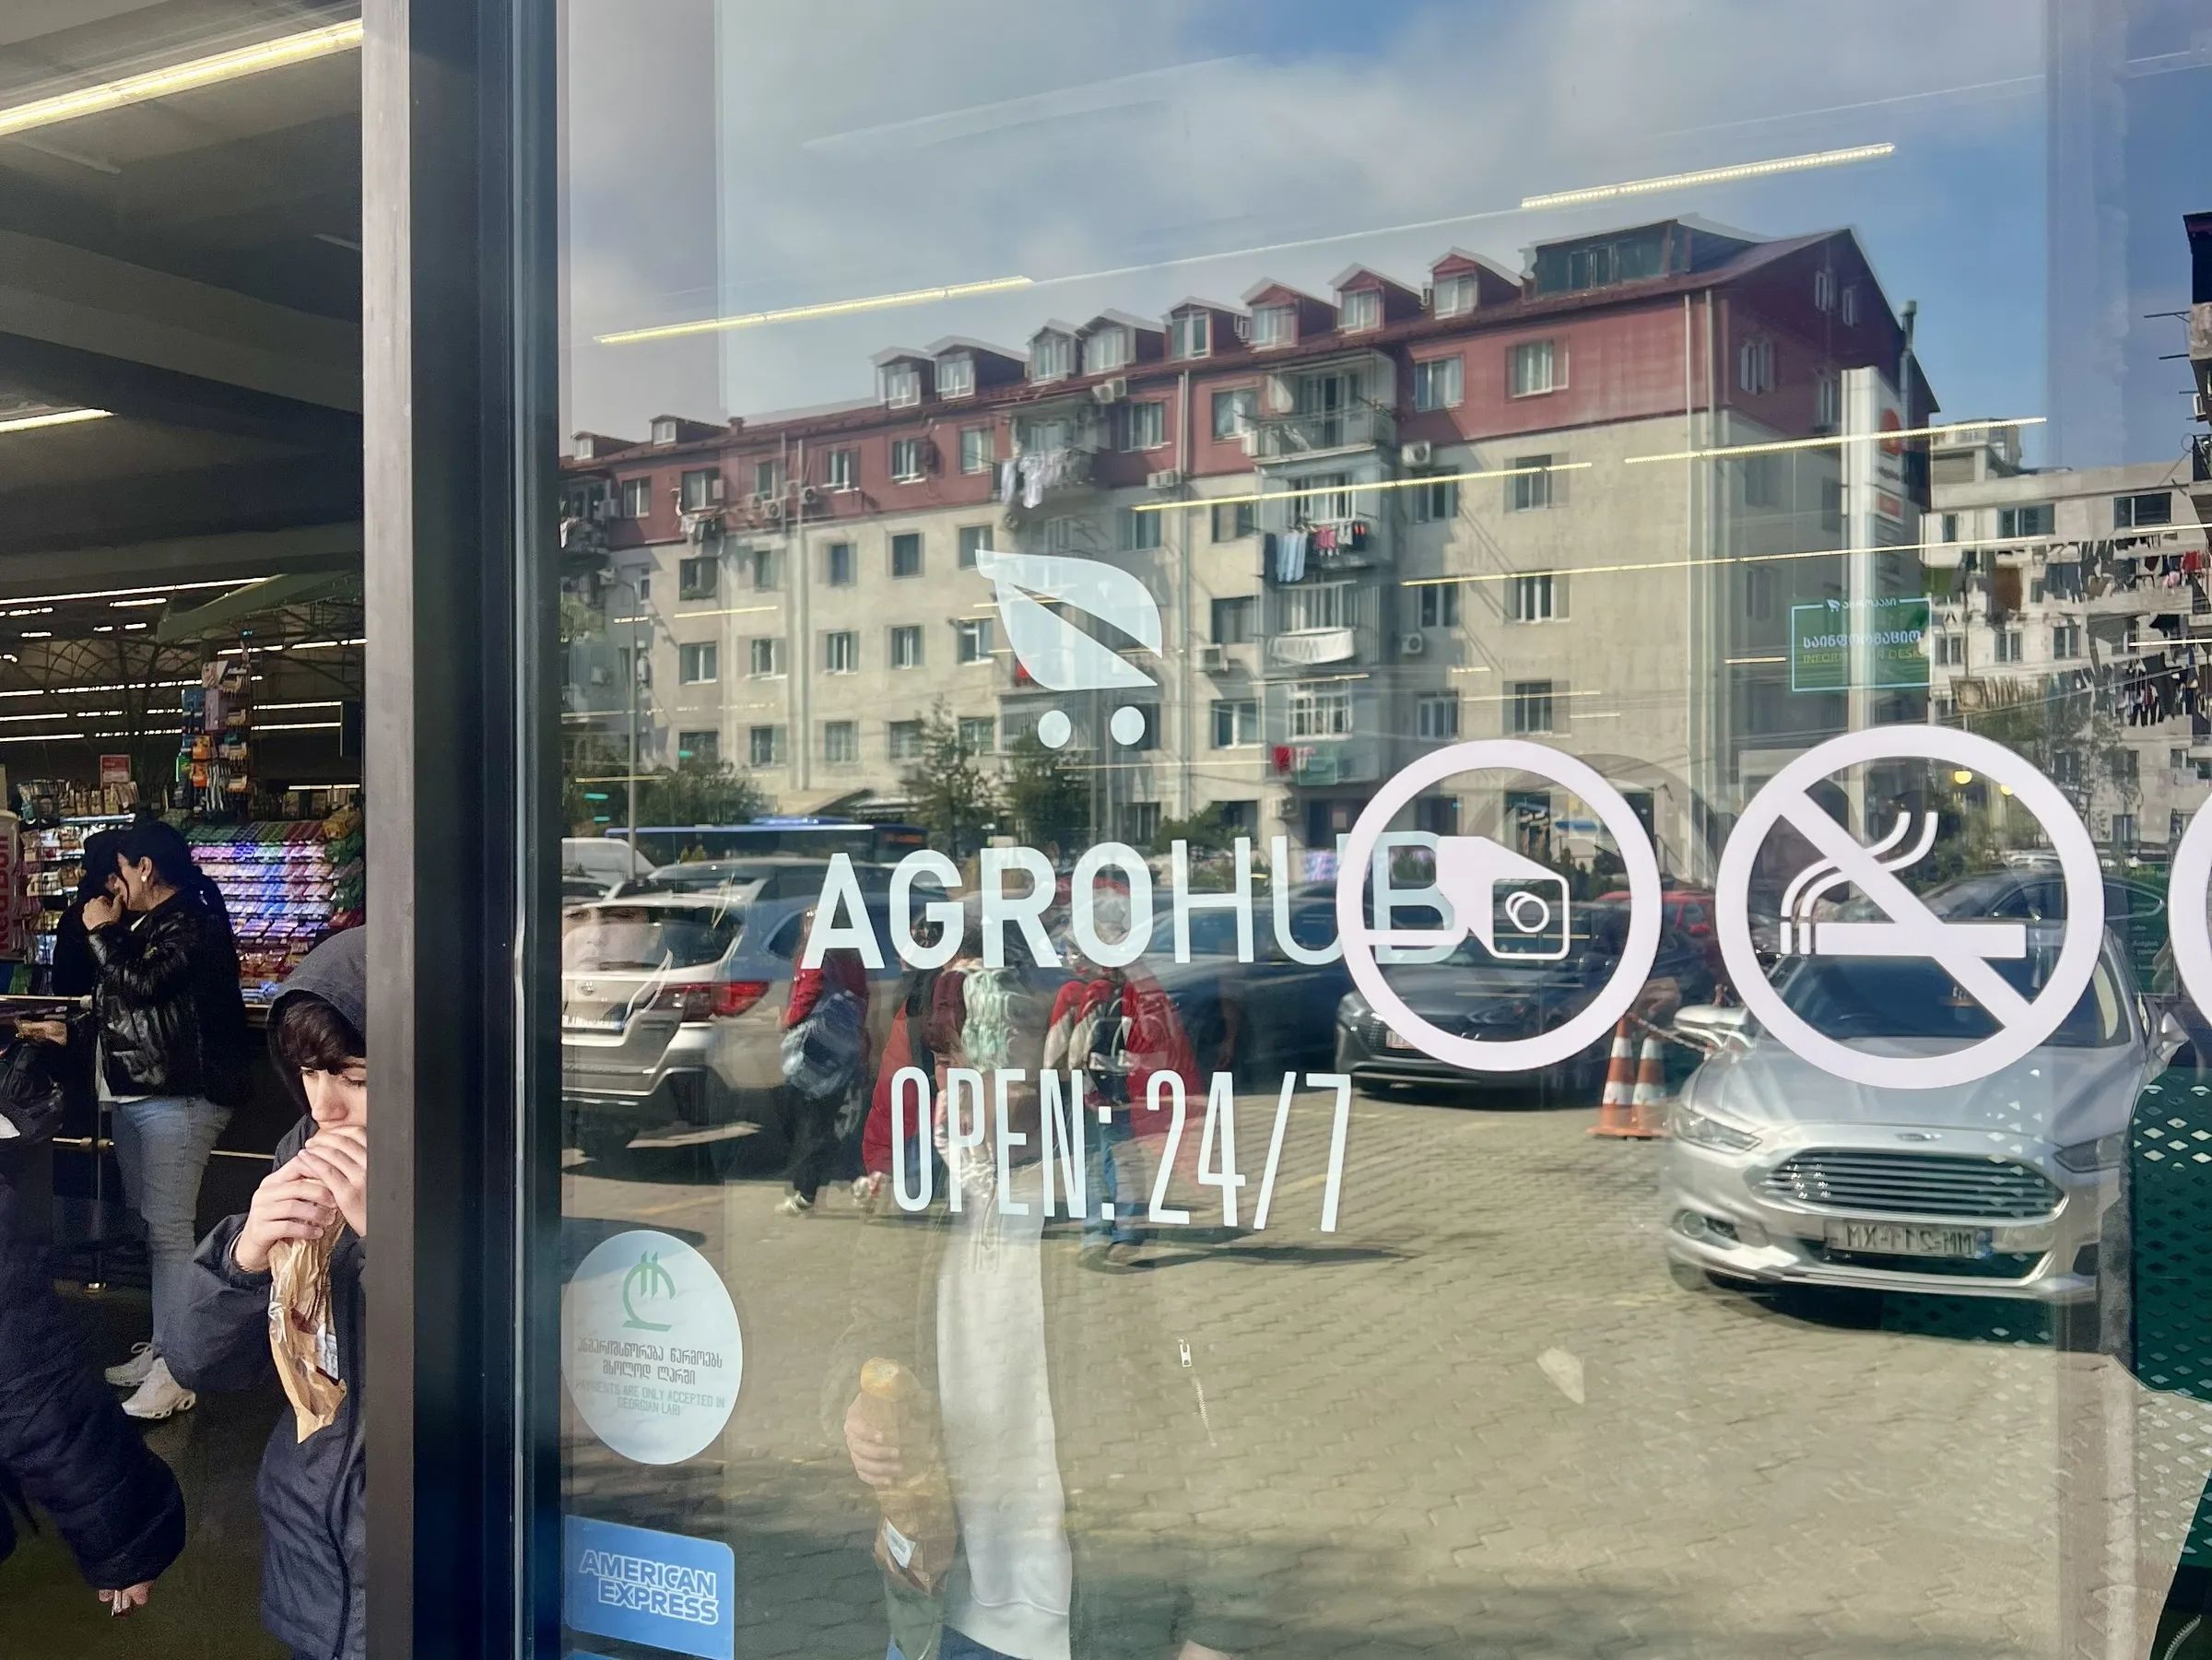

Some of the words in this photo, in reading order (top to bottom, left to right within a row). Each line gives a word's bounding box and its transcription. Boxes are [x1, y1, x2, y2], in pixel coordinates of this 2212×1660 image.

[801, 830, 1470, 971] AGROHUB
[890, 1066, 1116, 1221] OPEN:
[1146, 1070, 1352, 1233] 24/7
[623, 1384, 640, 1397] ARE
[642, 1387, 665, 1401] ONLY
[667, 1391, 713, 1407] ACCEPTED
[716, 1397, 725, 1409] IN
[661, 1403, 681, 1417] LARI
[579, 1549, 716, 1600] AMERICAN
[598, 1579, 719, 1626] EXPRESS
